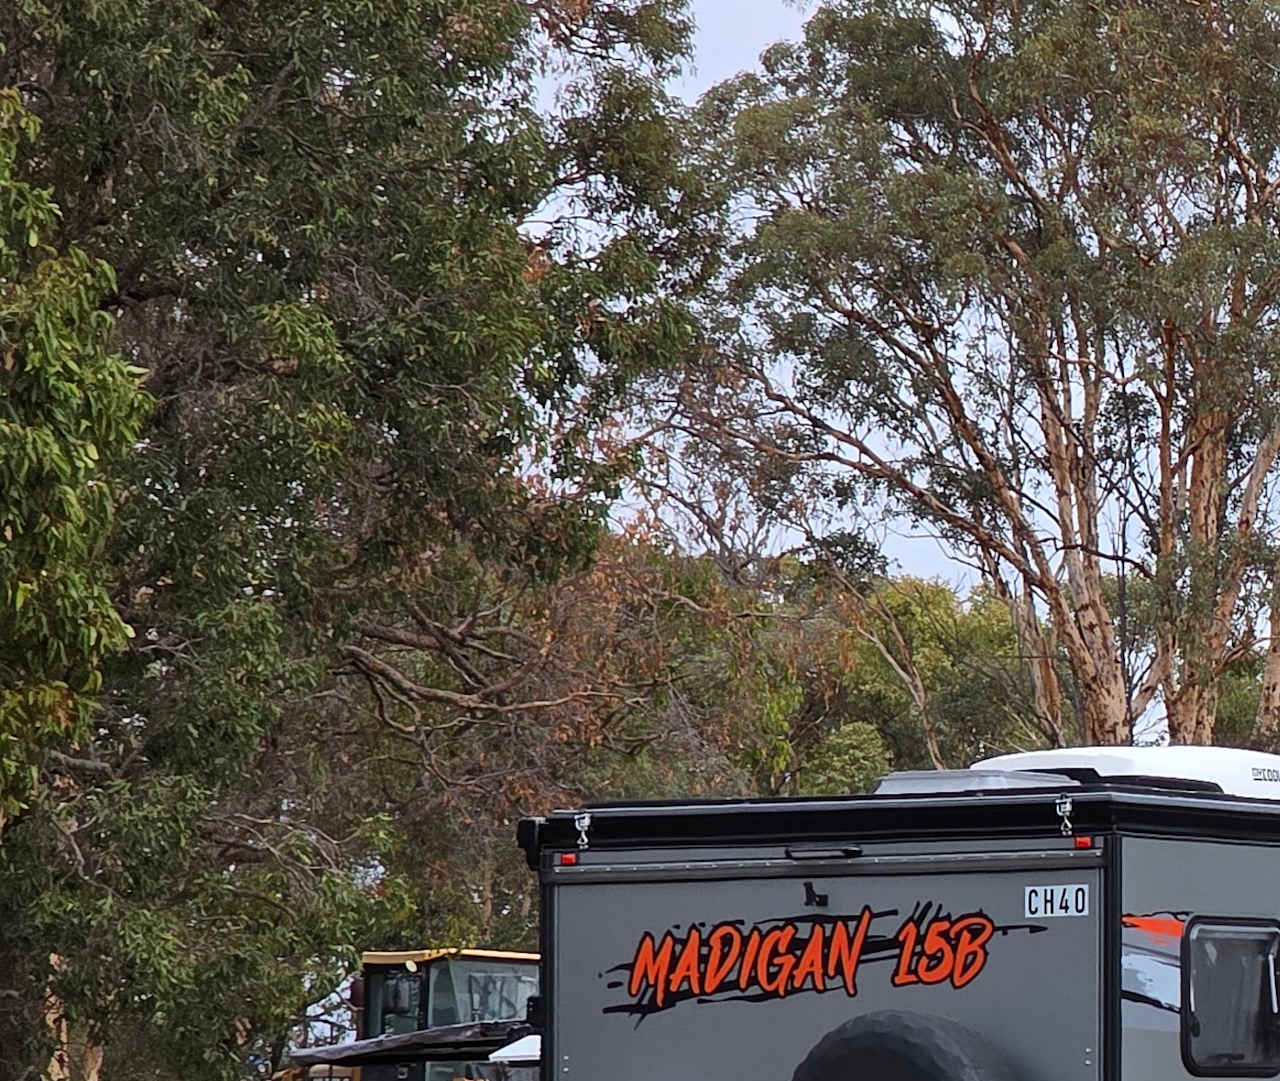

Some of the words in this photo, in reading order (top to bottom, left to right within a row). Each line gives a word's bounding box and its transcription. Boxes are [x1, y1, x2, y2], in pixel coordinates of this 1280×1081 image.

[1027, 886, 1087, 915] CH40
[627, 905, 871, 1008] MADIGAN
[891, 916, 996, 990] 15B
